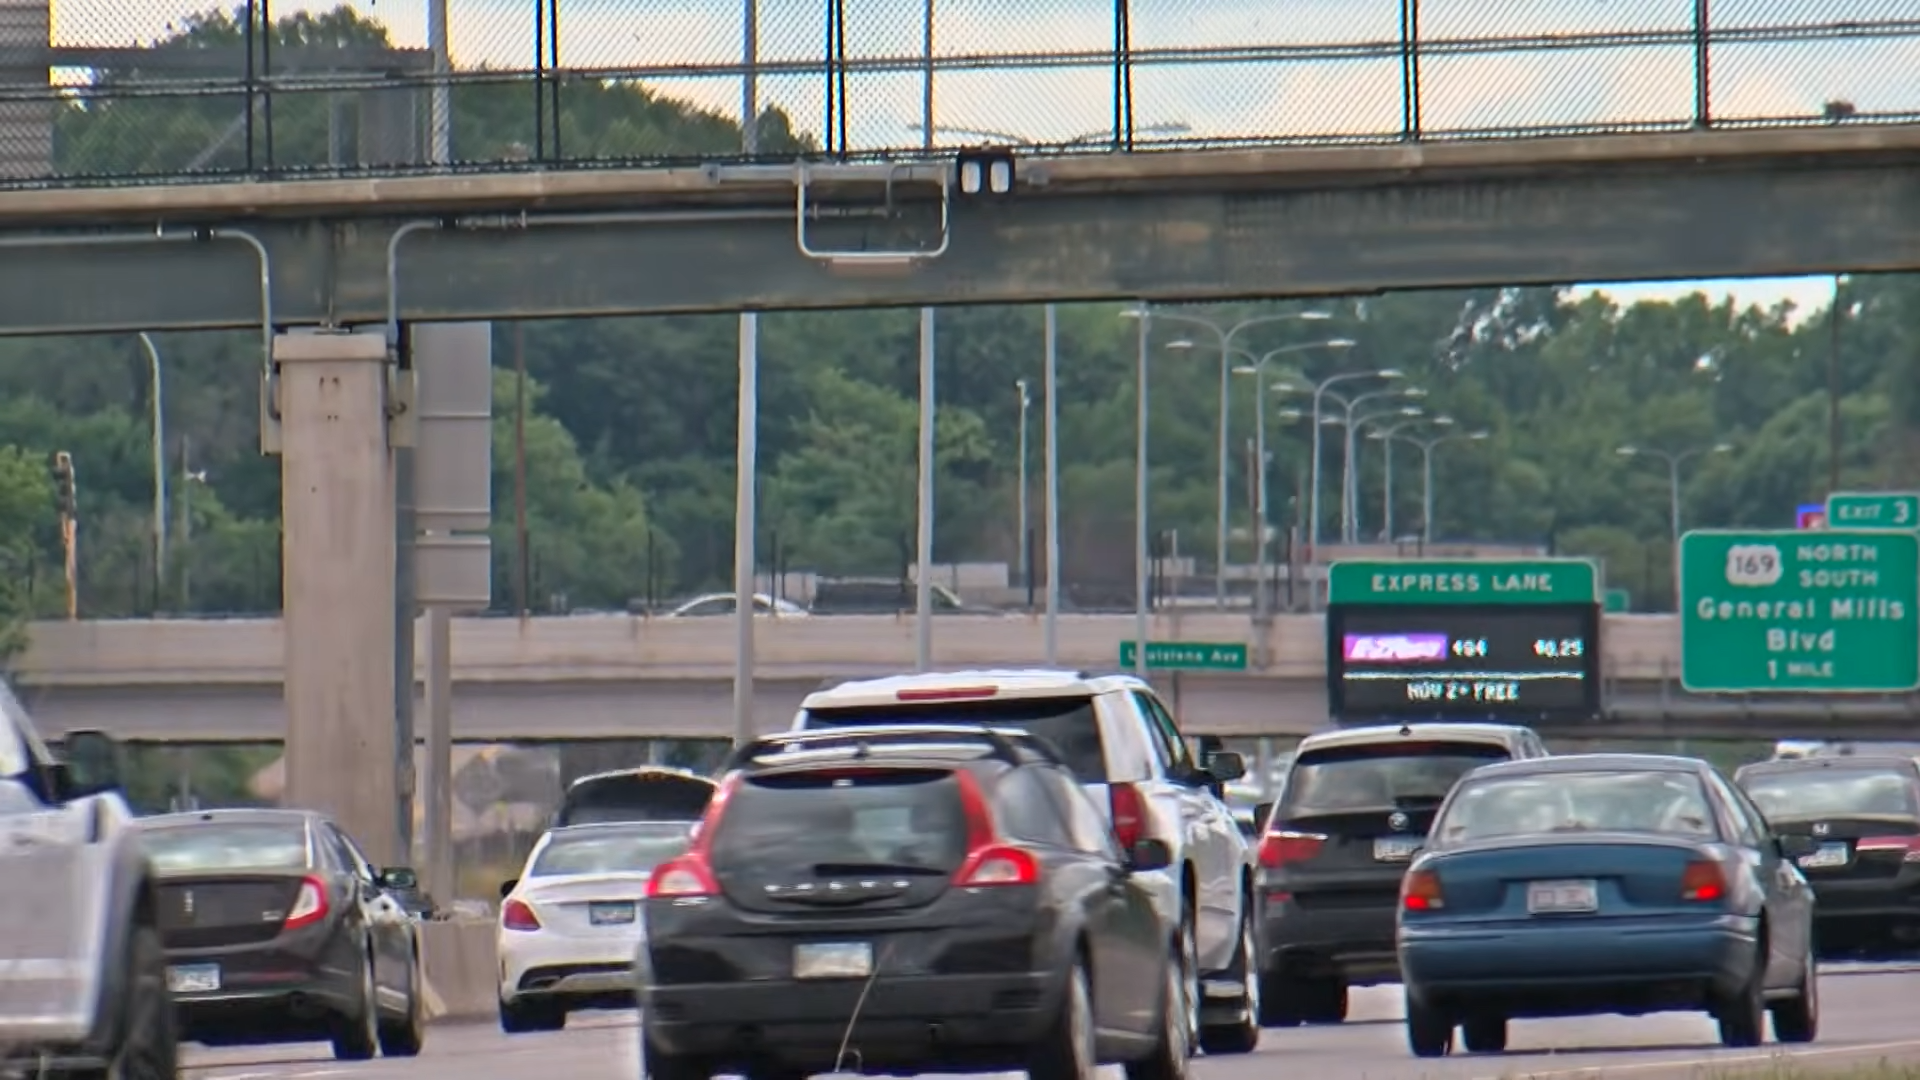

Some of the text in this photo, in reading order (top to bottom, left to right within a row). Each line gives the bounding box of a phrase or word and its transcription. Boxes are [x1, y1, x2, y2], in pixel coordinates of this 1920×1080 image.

[1838, 500, 1909, 524] EXIT 3
[1797, 545, 1877, 562] NORTH
[1735, 555, 1774, 576] 169
[1372, 573, 1553, 593] EXPRESS LANE
[1799, 569, 1877, 587] SOUTH
[1697, 597, 1905, 620] General Mills
[1767, 629, 1835, 651] Blvd
[1128, 648, 1239, 662] Luisiana Ave
[1768, 660, 1833, 680] 1 MILE
